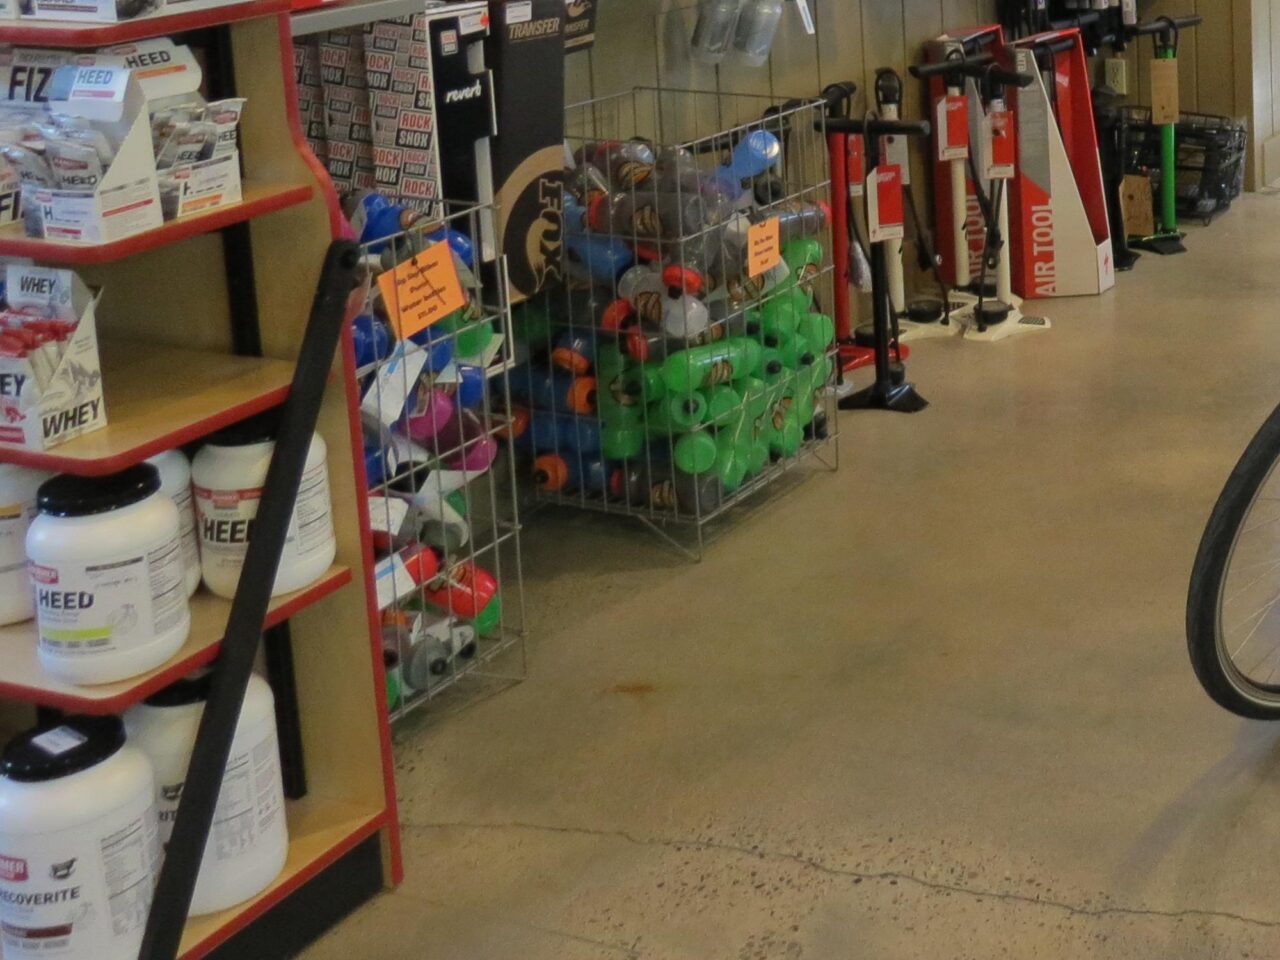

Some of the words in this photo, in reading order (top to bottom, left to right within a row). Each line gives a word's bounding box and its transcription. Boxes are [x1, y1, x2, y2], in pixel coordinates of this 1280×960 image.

[509, 18, 560, 39] TRANSFER
[126, 50, 171, 69] HEED
[76, 69, 113, 85] HEED
[445, 79, 482, 104] reverb
[402, 112, 432, 129] ROCK
[399, 130, 429, 147] SHOX
[403, 179, 433, 197] ROCK
[1031, 198, 1055, 257] TOOL
[20, 276, 56, 295] WHEY
[1035, 260, 1056, 297] AIR
[42, 397, 100, 438] WHEY
[39, 590, 94, 611] HEED
